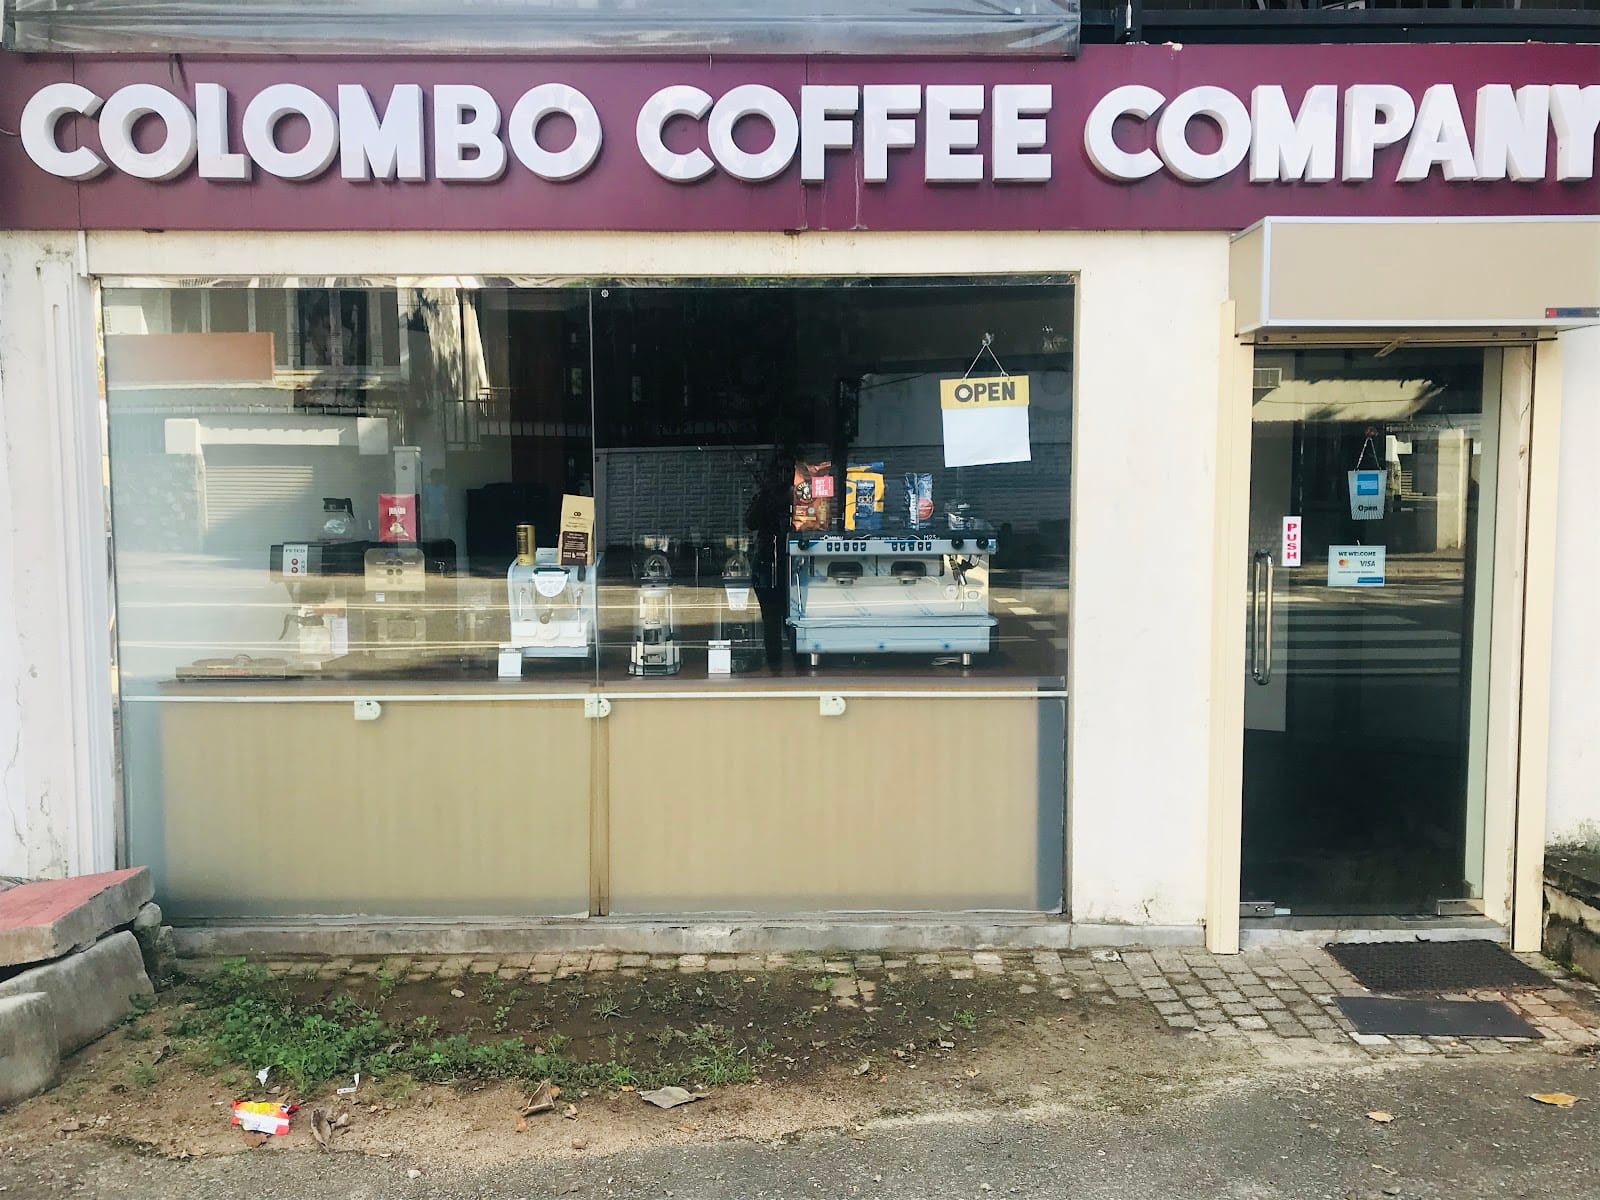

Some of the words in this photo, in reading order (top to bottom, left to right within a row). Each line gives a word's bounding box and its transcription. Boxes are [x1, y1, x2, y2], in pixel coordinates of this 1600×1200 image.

[20, 82, 603, 182] COLOMBO
[635, 84, 1053, 184] COFFEE
[1084, 83, 1600, 183] COMPANY
[954, 381, 1015, 402] OPEN
[1358, 504, 1378, 513] Open
[1287, 523, 1297, 559] PUSH
